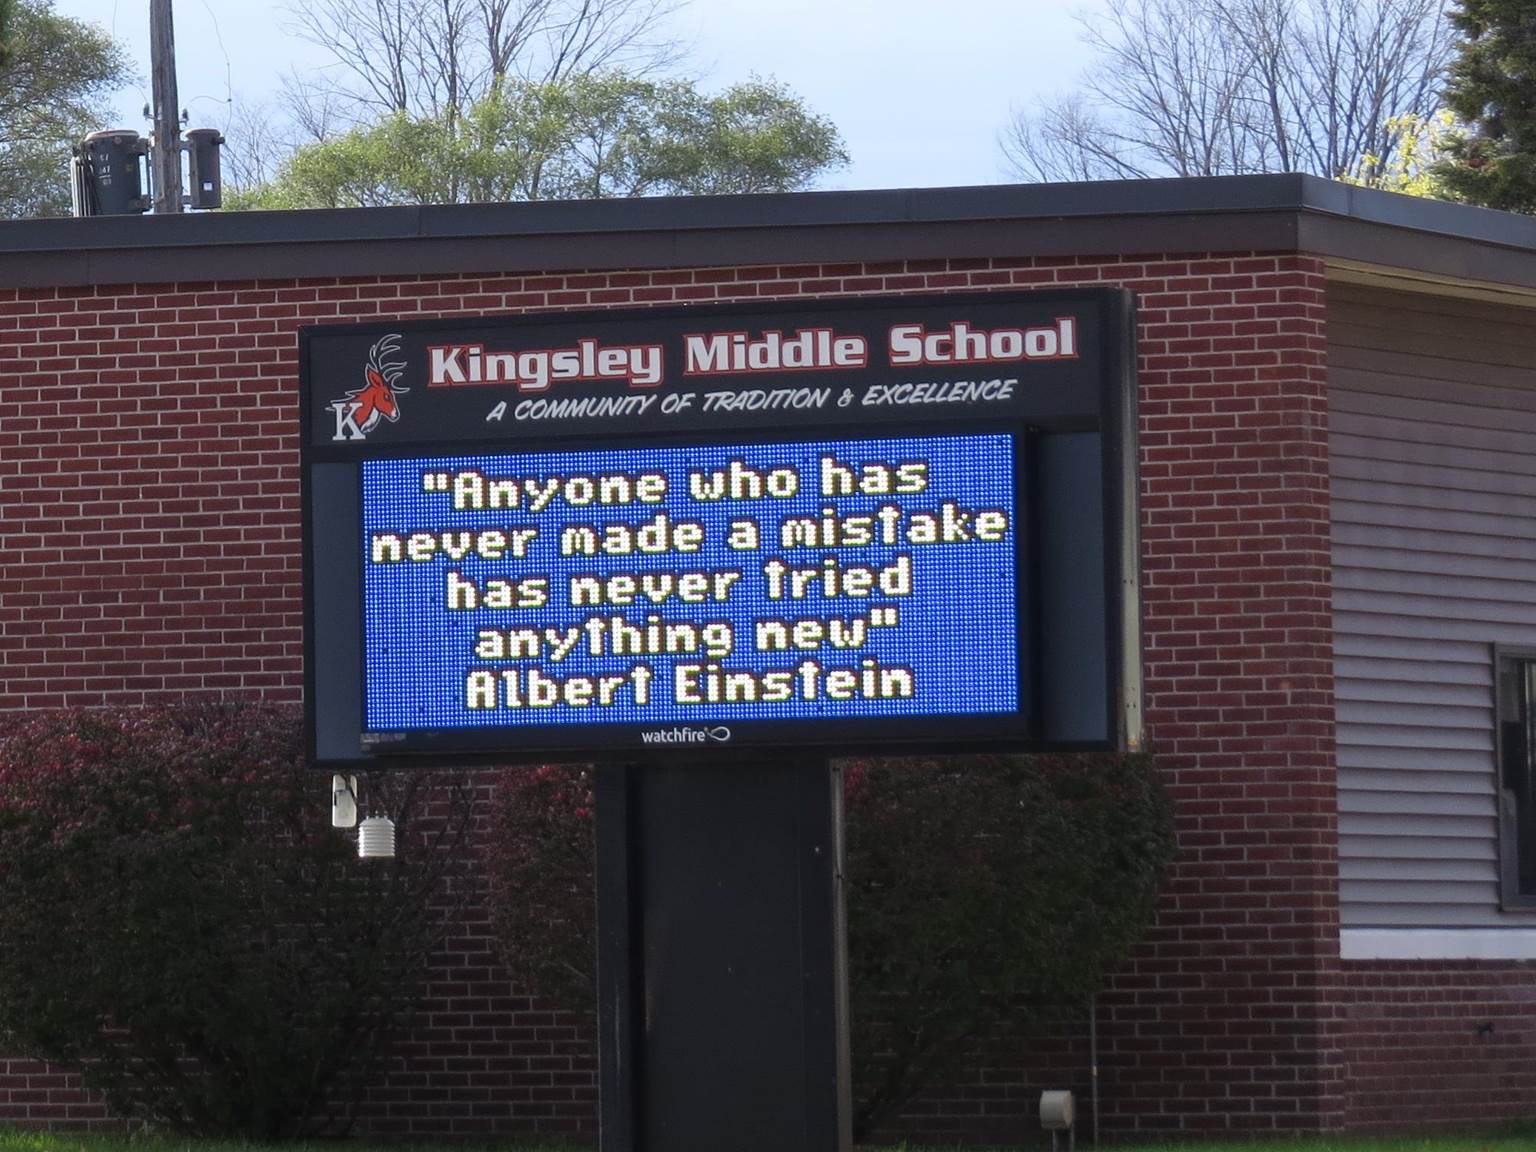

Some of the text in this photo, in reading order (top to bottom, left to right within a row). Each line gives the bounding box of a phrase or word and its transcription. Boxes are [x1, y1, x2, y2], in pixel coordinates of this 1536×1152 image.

[427, 317, 1079, 391] Kingsley Middle School
[332, 402, 366, 441] K
[486, 379, 1017, 422] A COMMUNITY OF TRADITION & EXCELLENCE
[424, 457, 927, 511] "Anyone who has
[372, 503, 1007, 562] never made a mistake
[447, 557, 912, 609] has never tried
[475, 608, 898, 662] anything new"
[467, 659, 912, 708] Albert Einstein
[641, 727, 706, 743] watchfire
